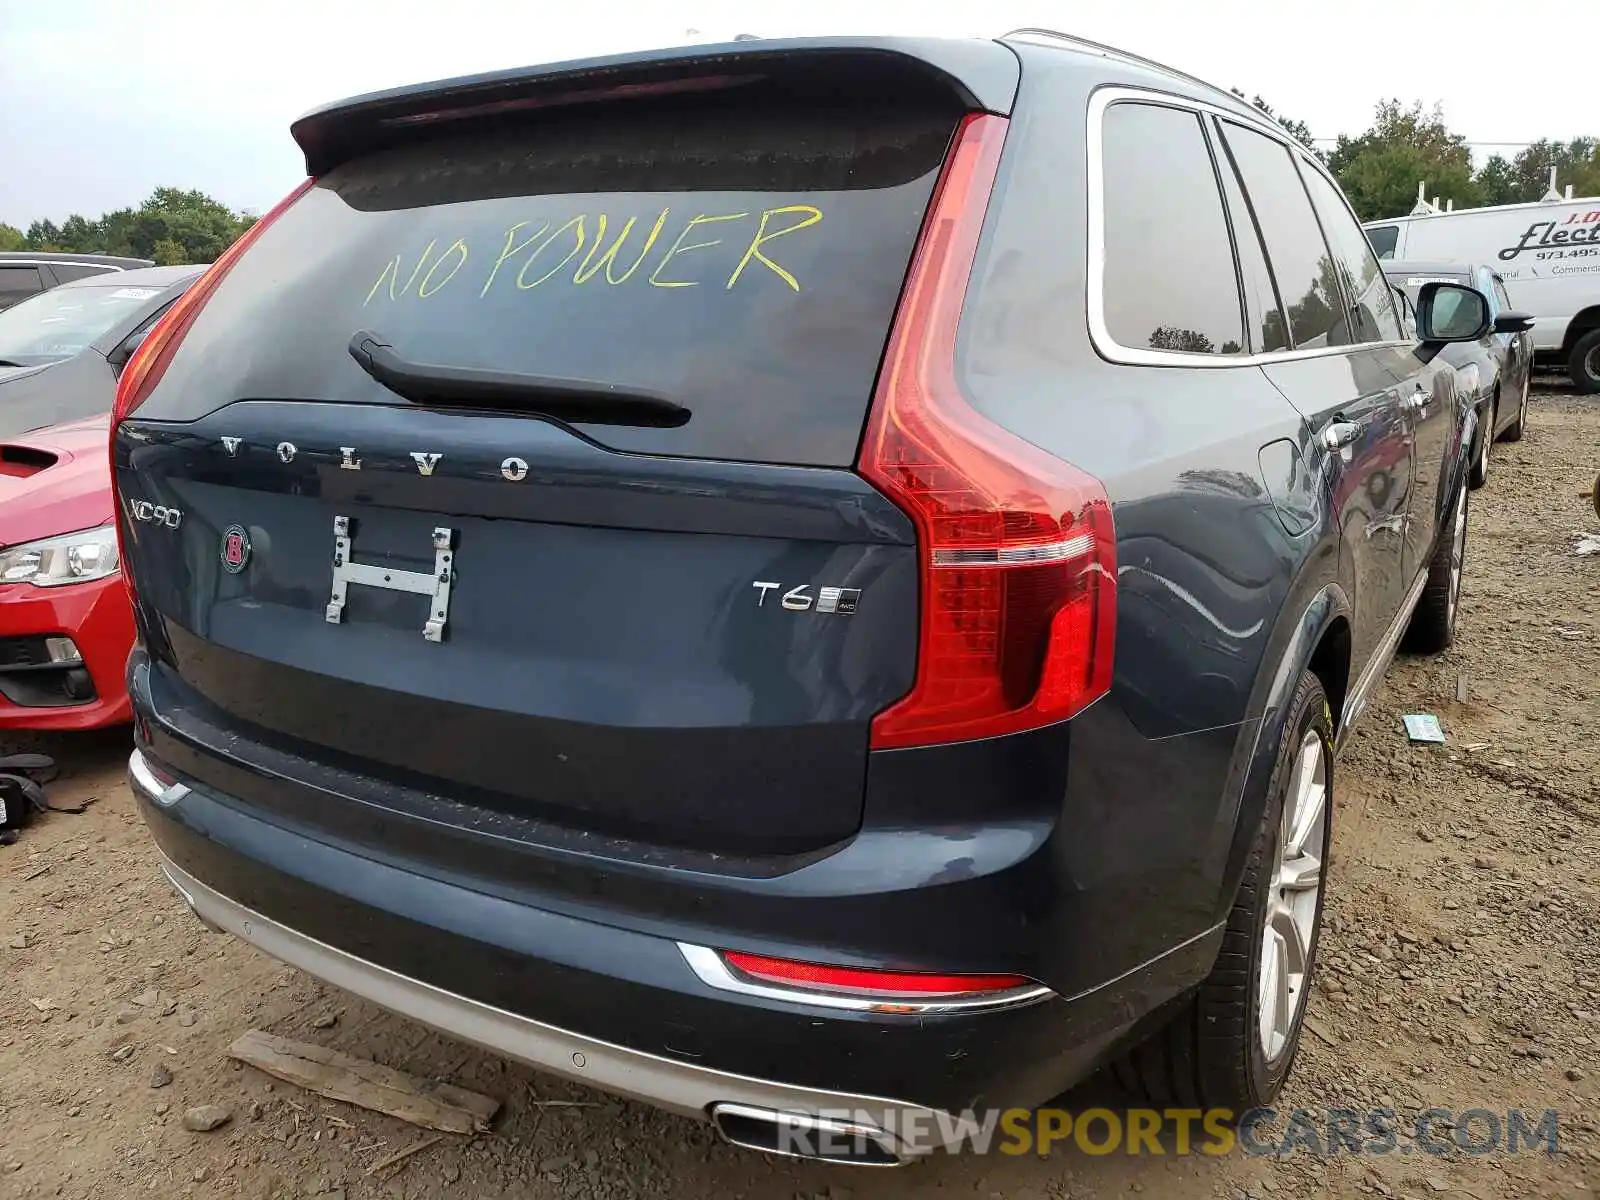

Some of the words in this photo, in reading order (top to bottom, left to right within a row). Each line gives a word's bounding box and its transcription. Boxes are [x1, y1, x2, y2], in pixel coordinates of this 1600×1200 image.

[363, 238, 468, 307] NO
[480, 205, 823, 299] POWER
[220, 435, 530, 481] VOLVO
[131, 499, 181, 529] XC90
[753, 581, 813, 610] T6
